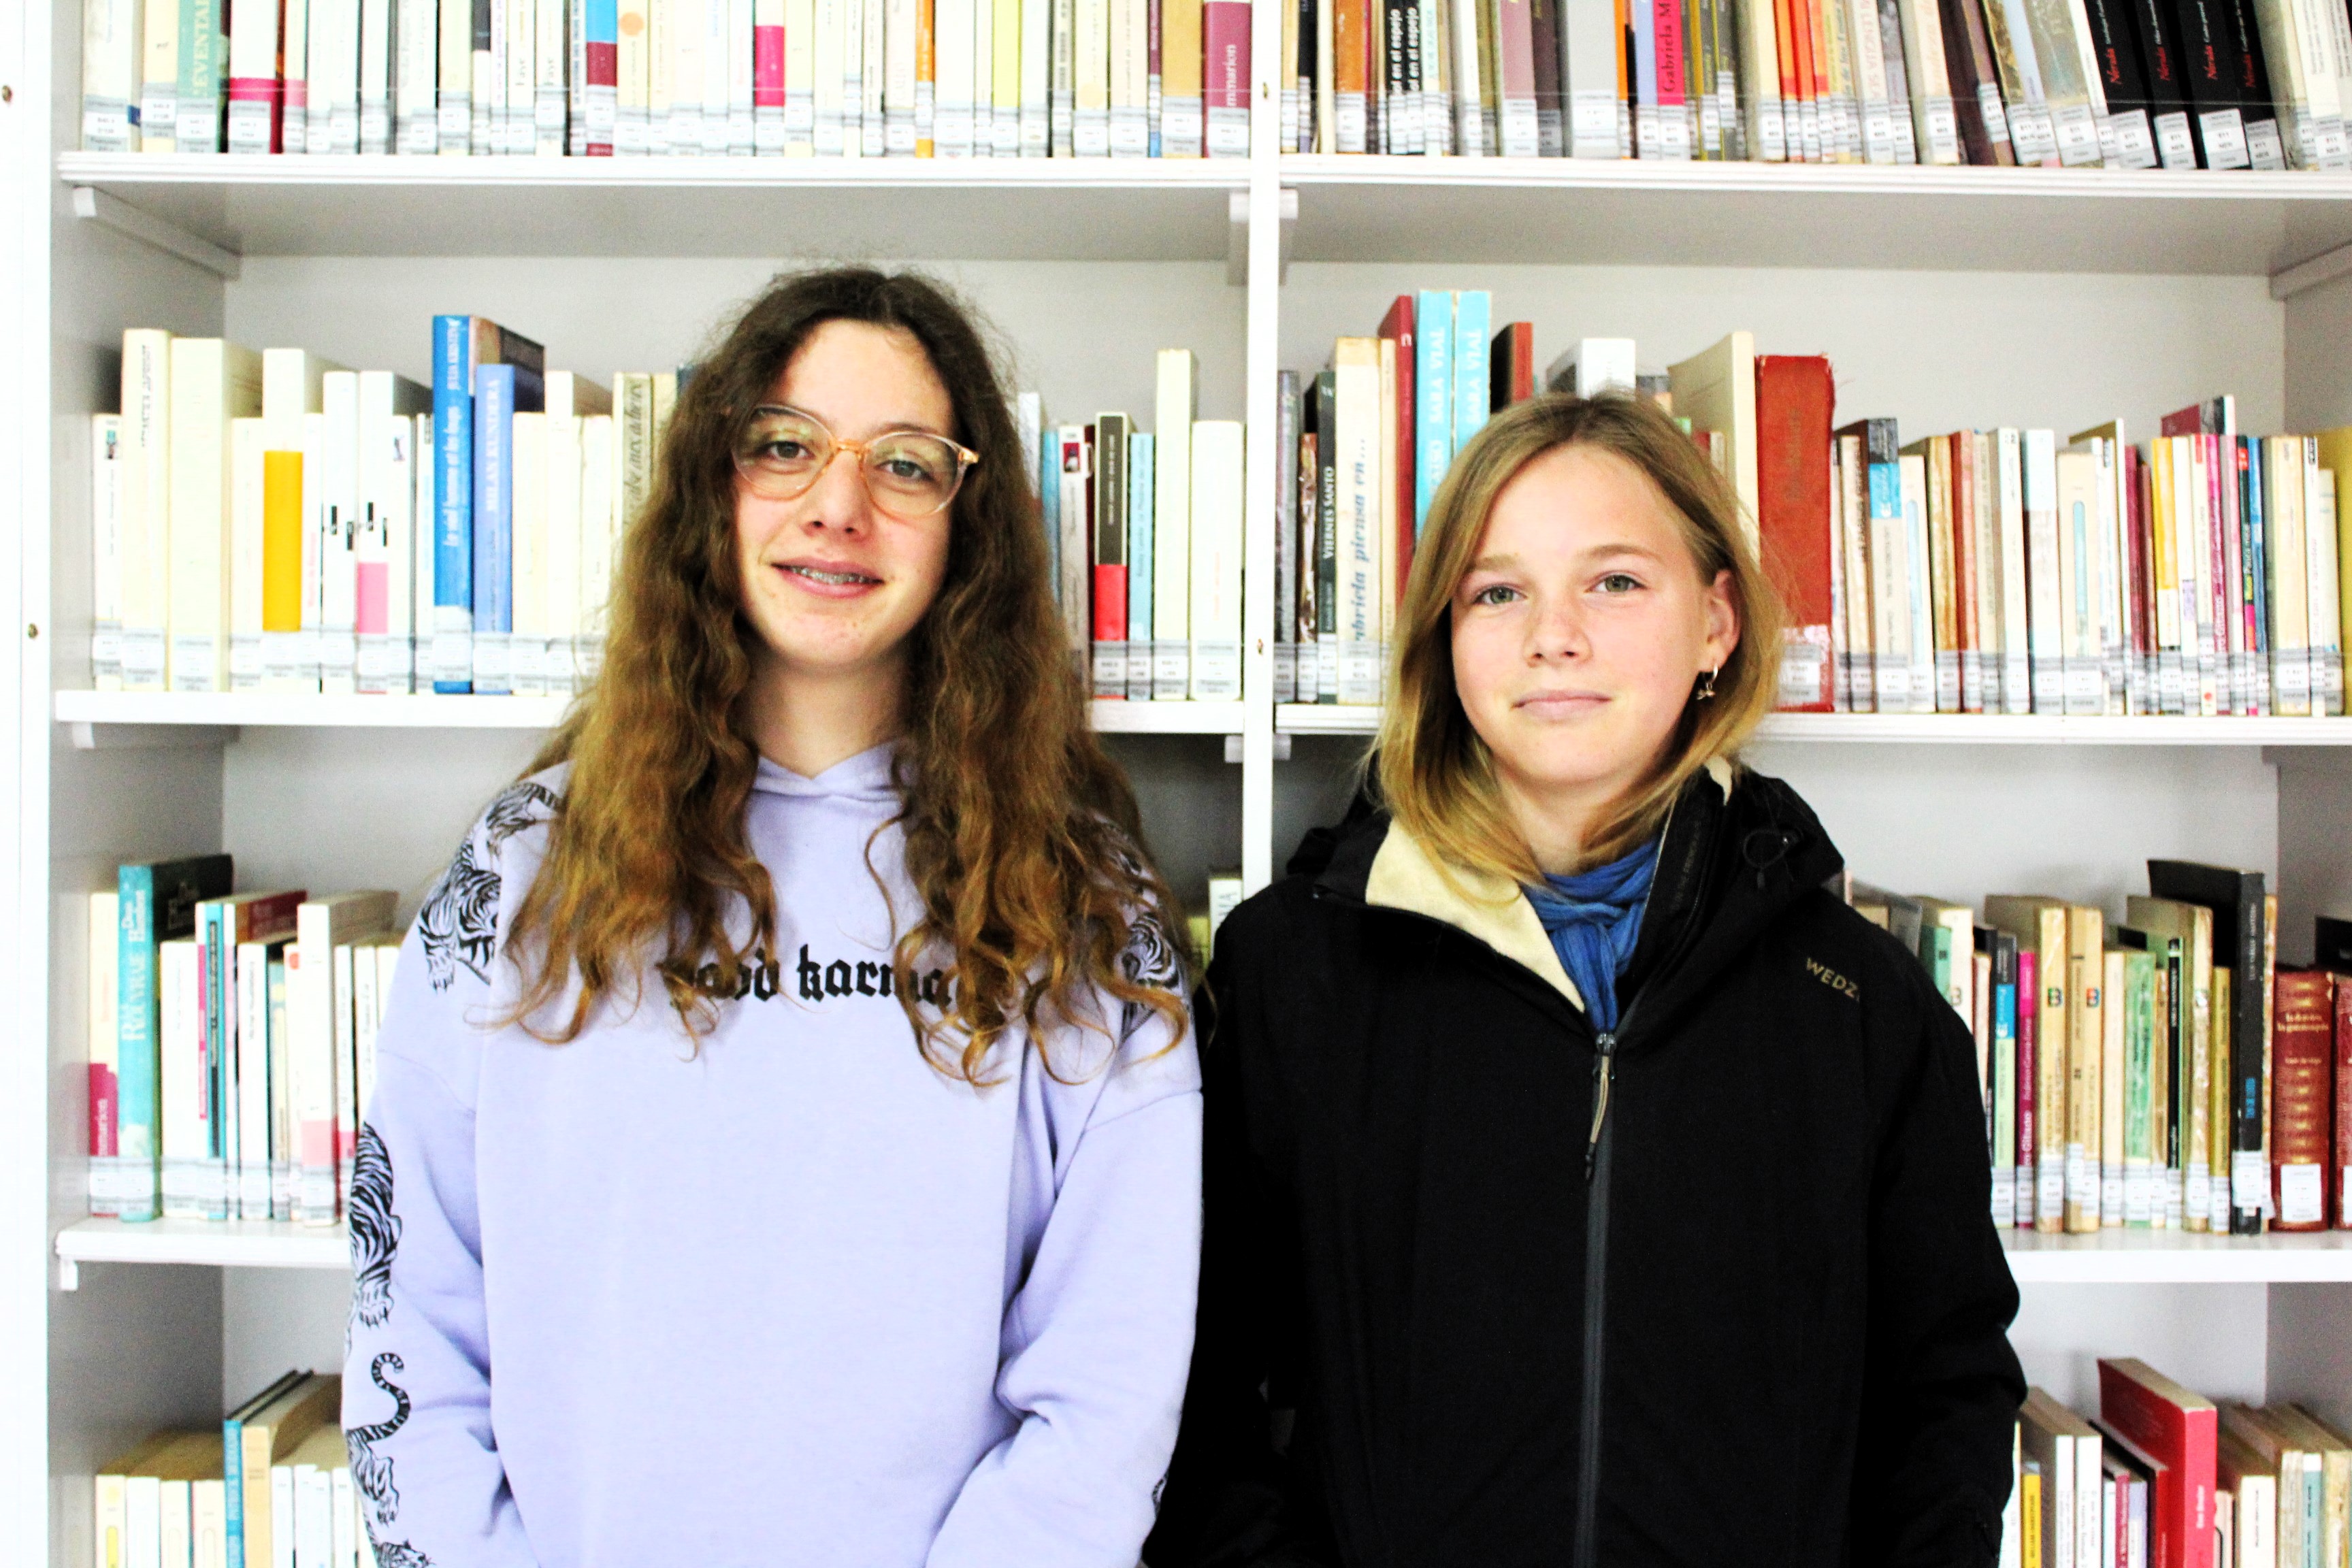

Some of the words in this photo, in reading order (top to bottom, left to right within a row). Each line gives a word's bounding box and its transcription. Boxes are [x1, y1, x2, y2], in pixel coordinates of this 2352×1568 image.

[1659, 24, 1676, 93] Gabriela
[486, 379, 501, 458] KUNDERA
[1322, 466, 1335, 508] SANTO
[1322, 510, 1335, 559] VIERNES
[1806, 957, 1860, 1002] WEDZ
